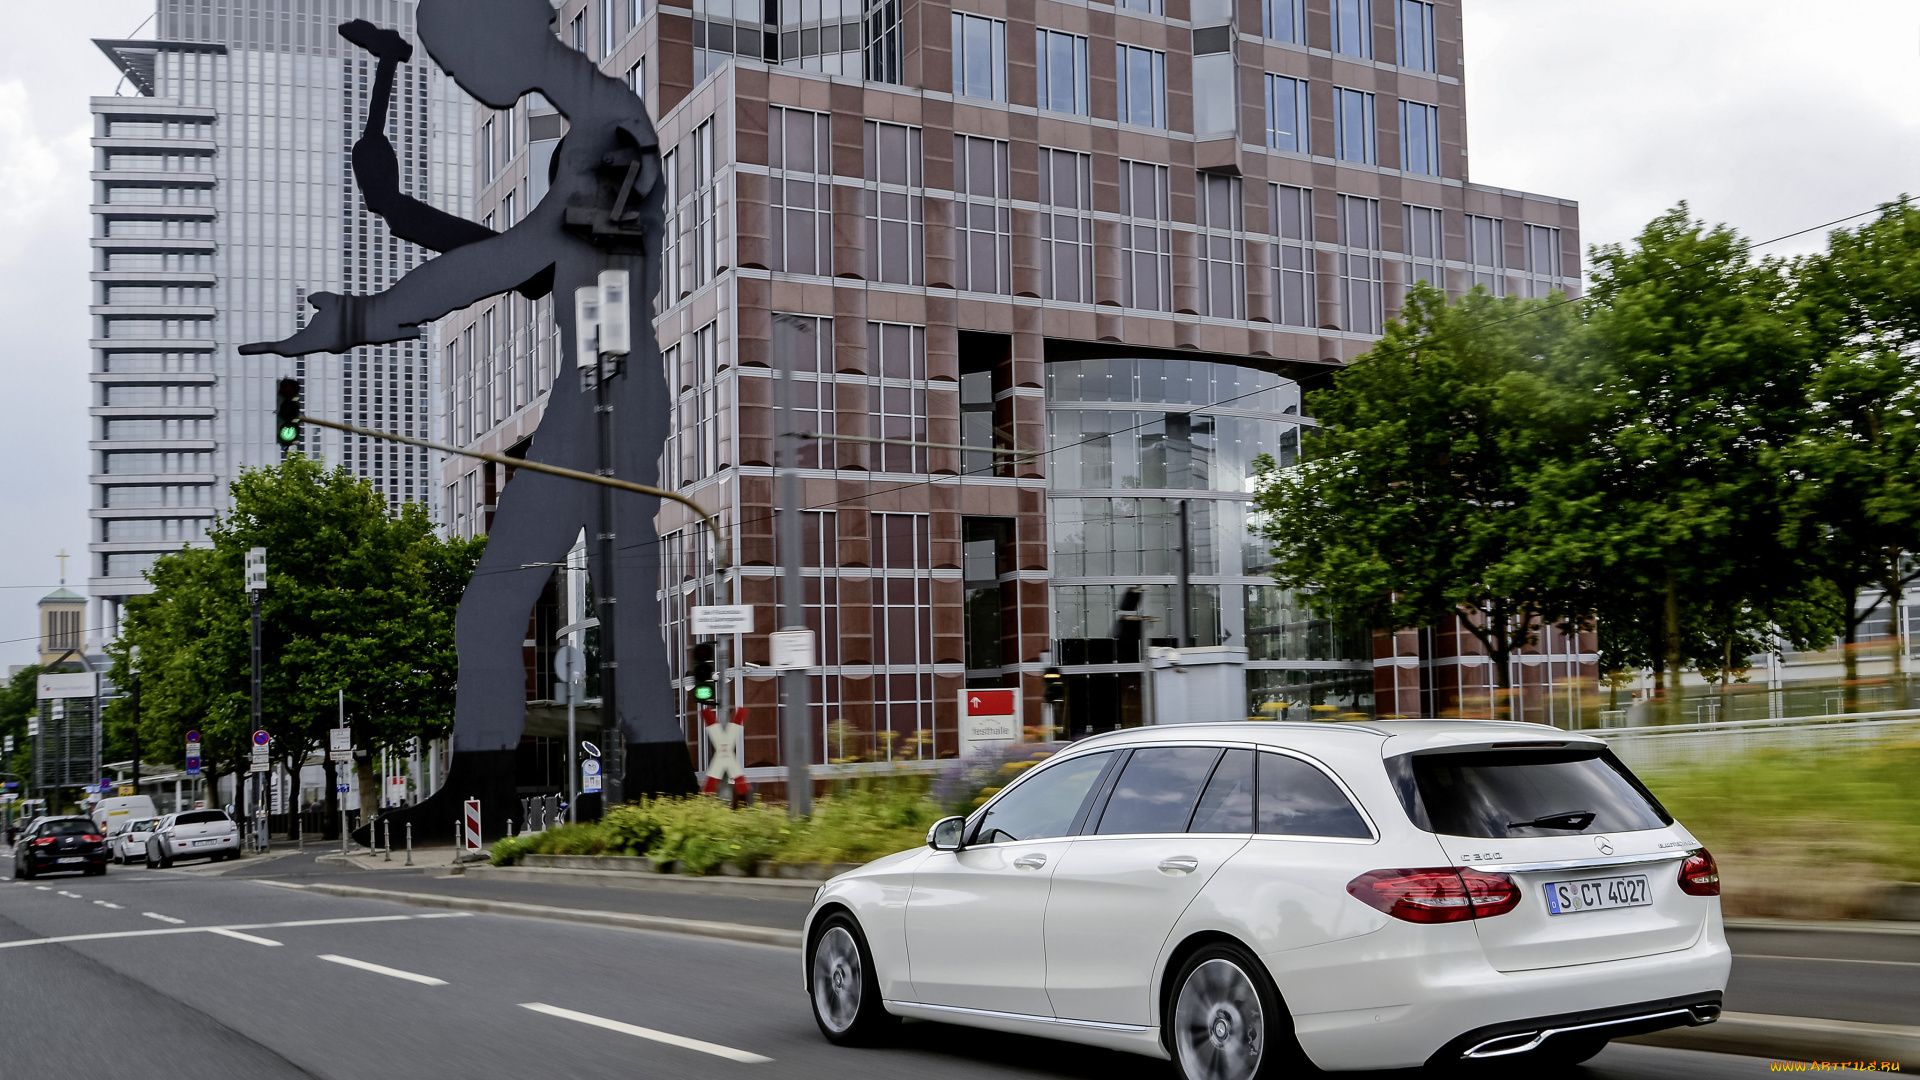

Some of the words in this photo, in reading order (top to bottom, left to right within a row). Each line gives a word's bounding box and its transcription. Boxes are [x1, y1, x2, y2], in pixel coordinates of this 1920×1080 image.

[1473, 852, 1503, 861] 300
[1558, 885, 1571, 909] S
[1580, 882, 1602, 907] CT
[1607, 878, 1647, 904] 4027
